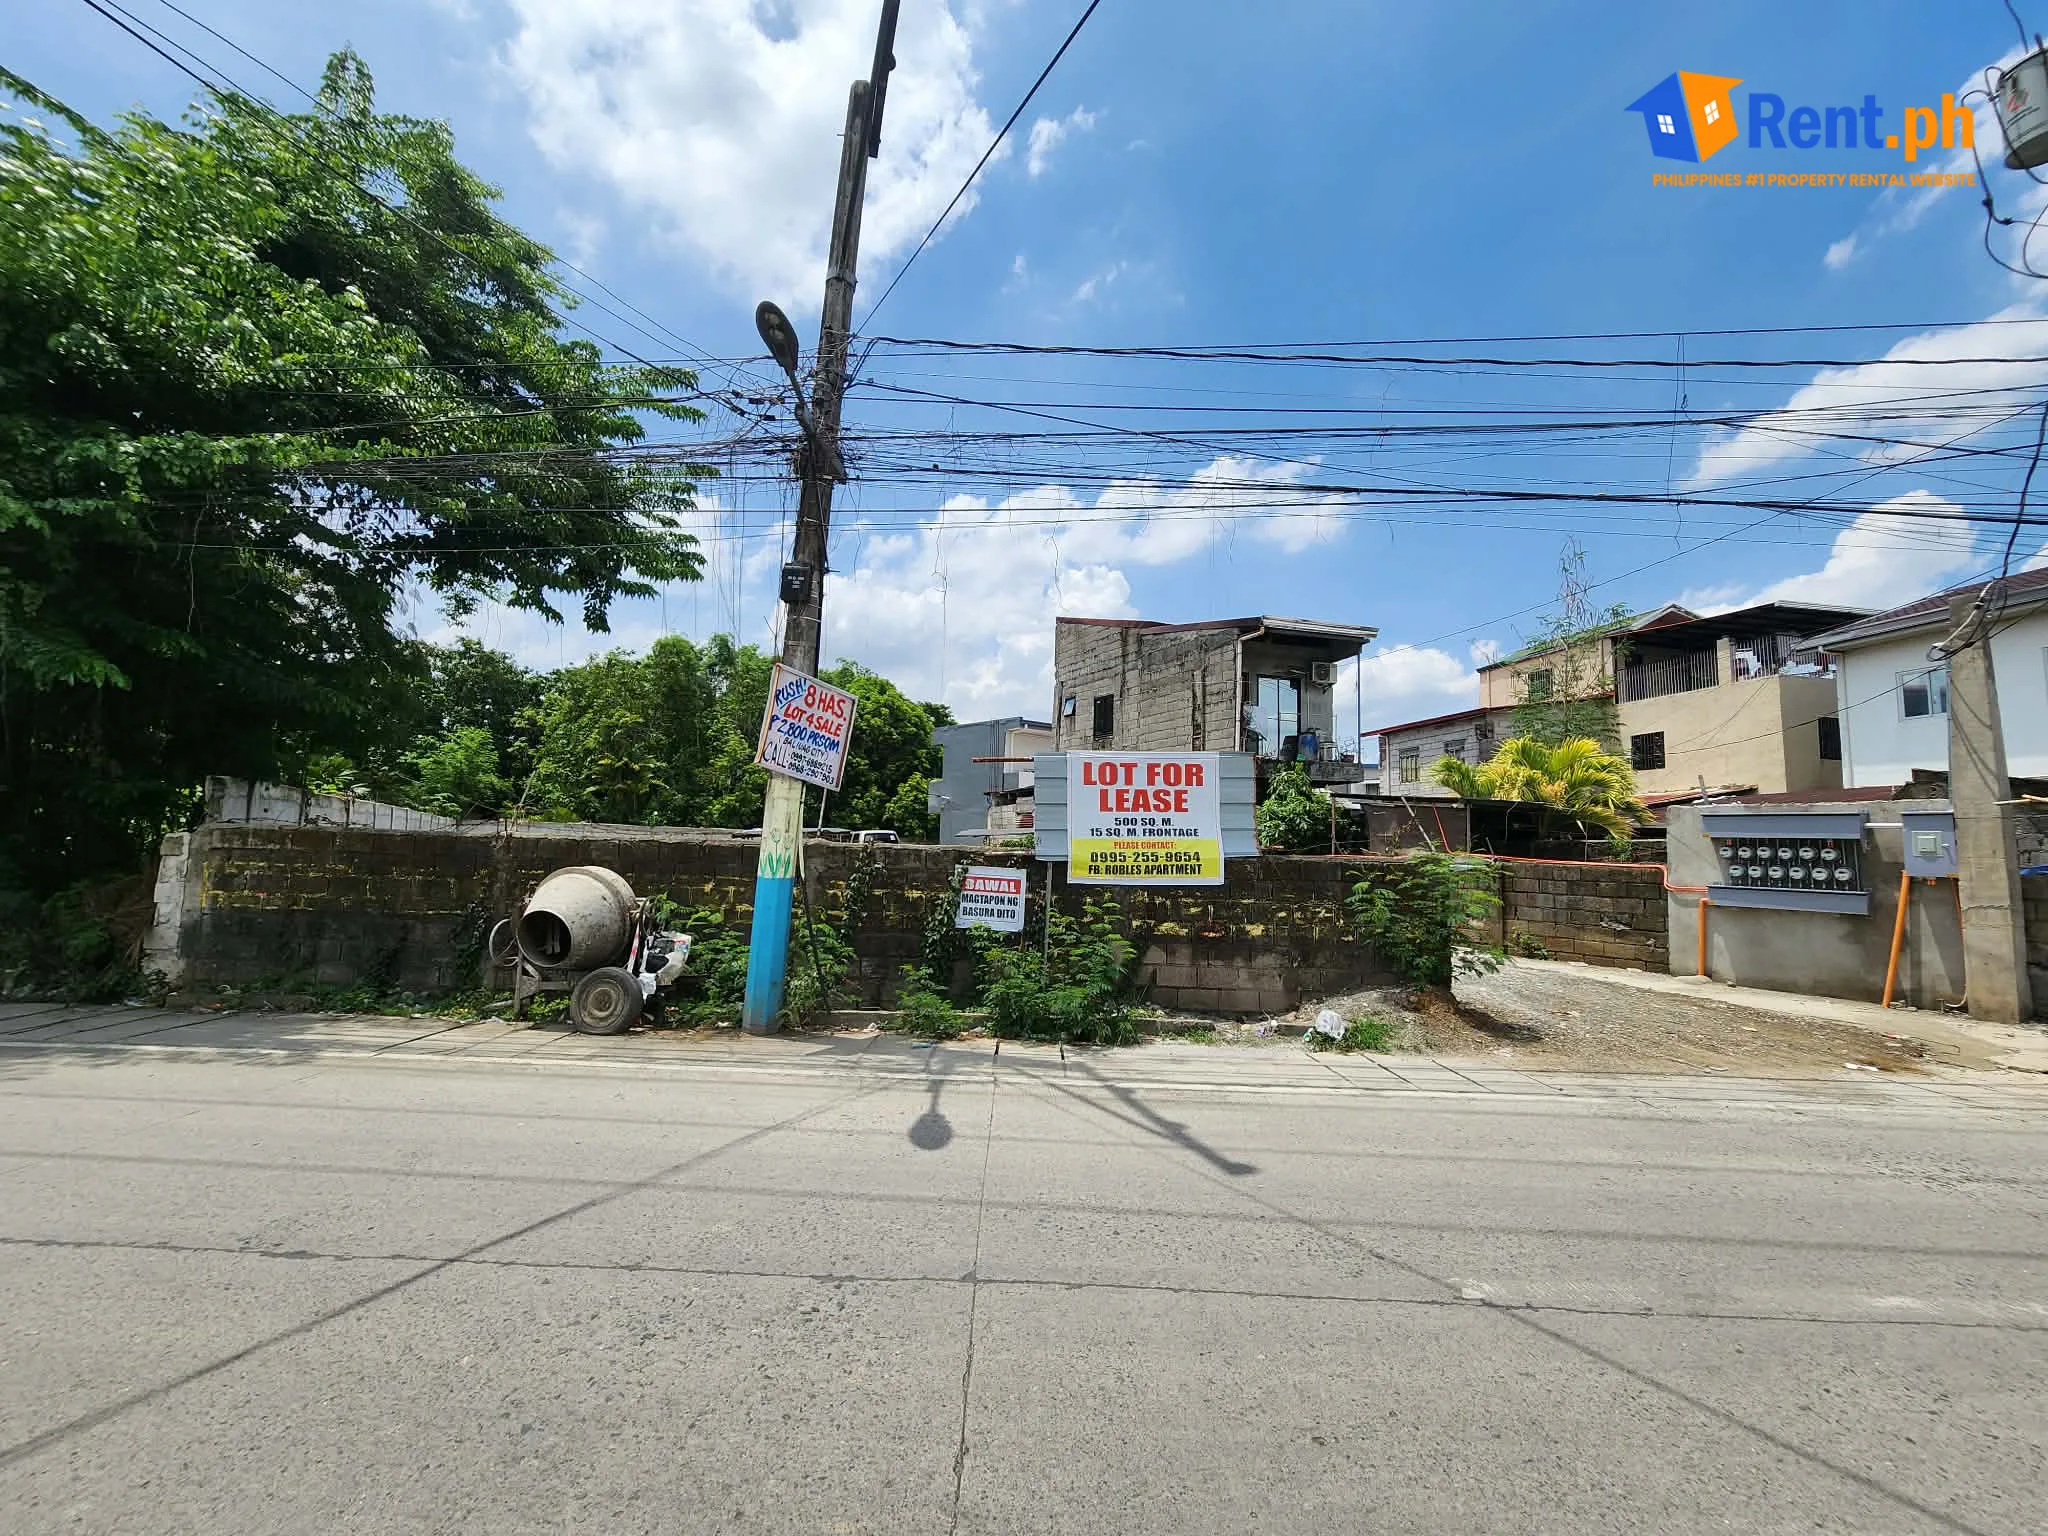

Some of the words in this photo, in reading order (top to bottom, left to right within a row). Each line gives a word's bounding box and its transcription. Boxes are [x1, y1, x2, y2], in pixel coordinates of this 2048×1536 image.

[775, 678, 807, 707] RUSH!
[804, 684, 816, 708] 8
[817, 690, 847, 722] HAS.
[784, 703, 807, 722] LOT
[806, 713, 815, 727] 4
[815, 716, 843, 737] SALE
[1083, 762, 1138, 786] LOT
[1146, 763, 1204, 787] FOR
[1099, 789, 1188, 812] LEASE
[1114, 817, 1138, 827] 500
[1140, 817, 1159, 827] SQ.
[1162, 817, 1174, 827] M.
[1090, 828, 1103, 837] 15
[1106, 828, 1124, 837] SQ.
[1126, 828, 1140, 837] M.
[1143, 828, 1199, 837] FRONTAGE
[1113, 841, 1141, 849] PLEASE
[1090, 851, 1201, 863] 0995-255-9654
[1088, 864, 1103, 875] FB:
[1105, 864, 1142, 875] ROBLES
[1144, 864, 1202, 875] APARTMENT
[965, 879, 1017, 893] BAWAL
[961, 894, 1005, 906] MAGTAPON
[1007, 896, 1018, 906] NG
[962, 907, 994, 918] BASURA
[997, 909, 1016, 919] DITO
